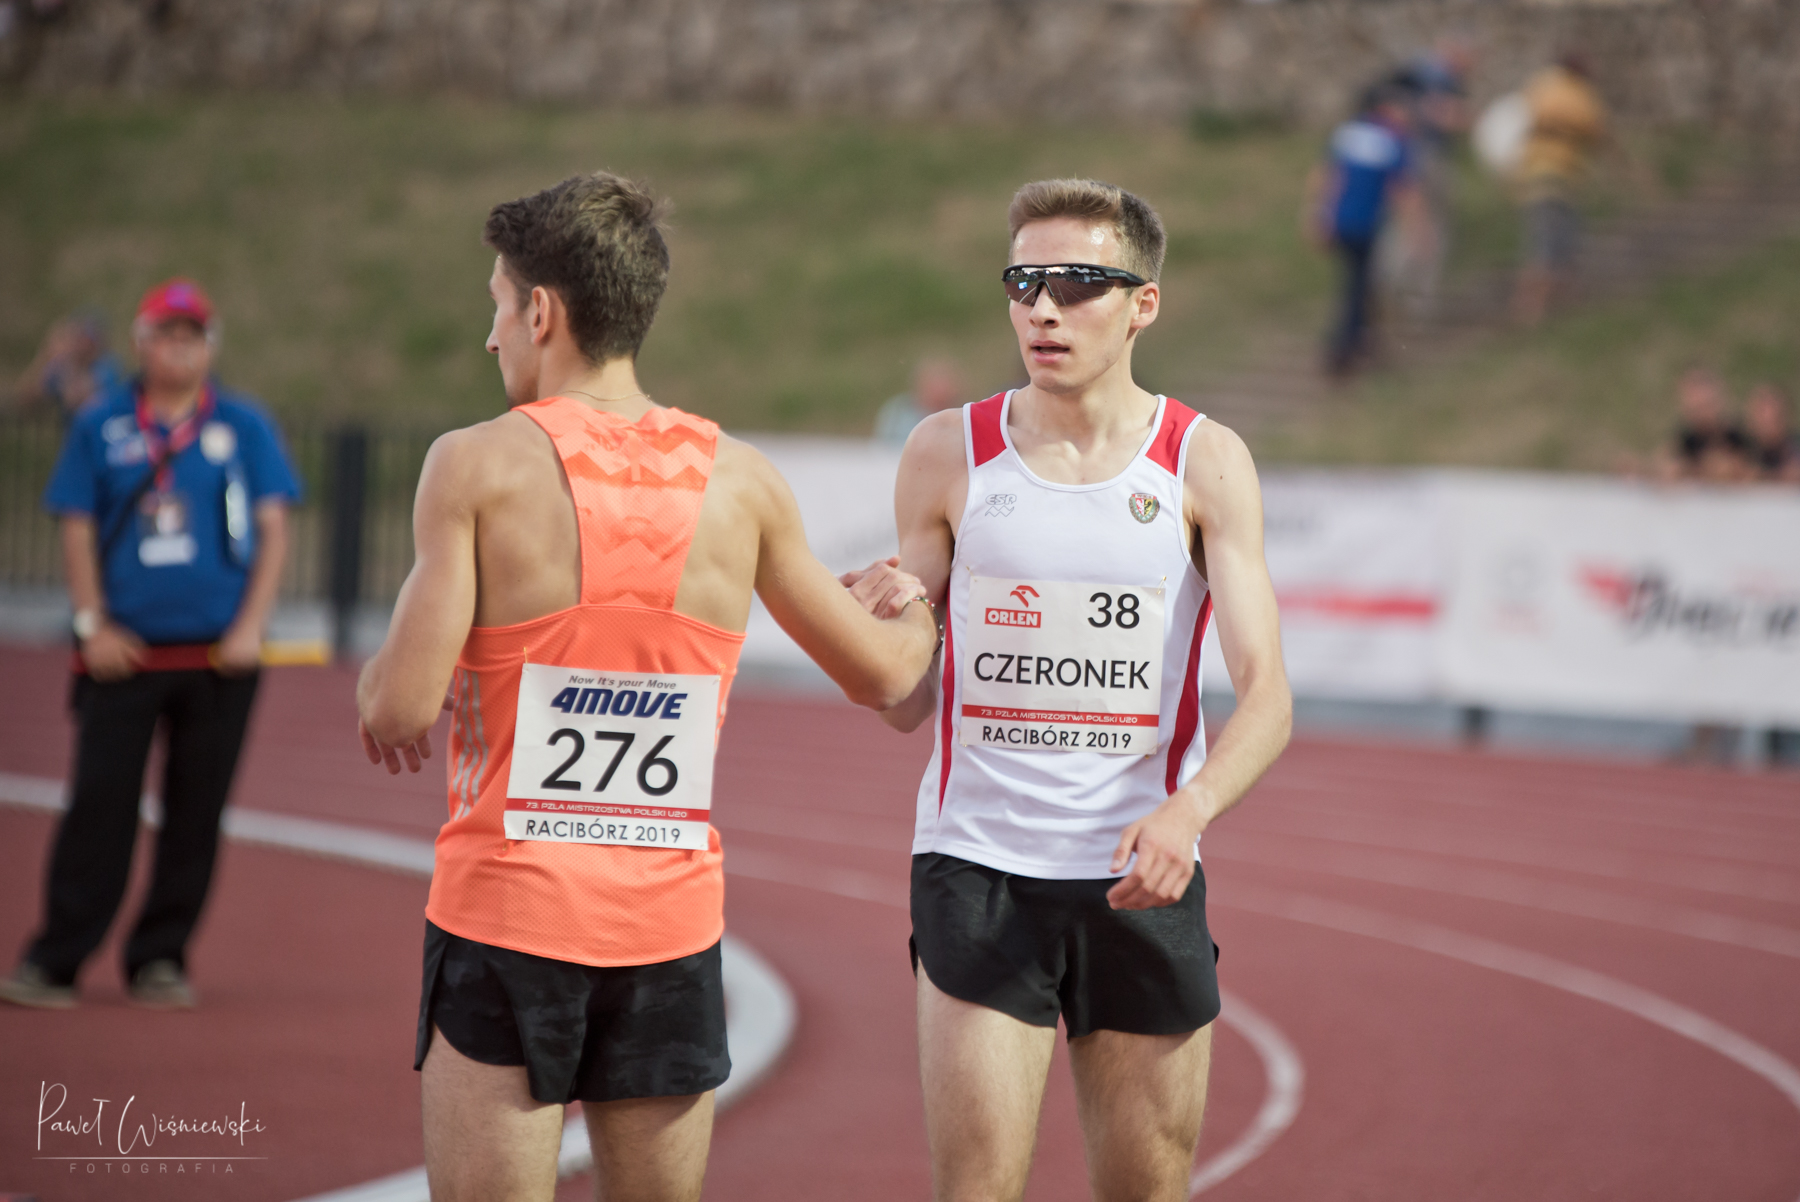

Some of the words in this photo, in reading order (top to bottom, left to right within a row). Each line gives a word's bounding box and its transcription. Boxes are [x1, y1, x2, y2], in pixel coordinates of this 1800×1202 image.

[987, 610, 1039, 626] ORLEN
[1087, 592, 1140, 629] 38
[568, 675, 595, 685] Now
[597, 676, 615, 686] It's
[617, 679, 643, 689] your
[646, 679, 677, 690] Move
[974, 652, 1150, 690] CZERONEK
[549, 687, 688, 720] 4MOVE
[995, 710, 1019, 718] PZLA
[1020, 712, 1084, 722] MISTRZOSTWA
[1086, 715, 1117, 723] POLSKI
[1119, 716, 1138, 724] U20
[982, 725, 1080, 747] RACIBÓRZ
[1086, 732, 1132, 749] 2019
[540, 727, 679, 796] 276
[525, 801, 539, 809] 73.
[541, 802, 565, 811] PZLA
[566, 804, 632, 815] MISTRZOSTWA
[633, 808, 666, 818] POLSKI
[668, 810, 687, 818] U20
[525, 818, 628, 840] RACIBÓRZ
[634, 825, 681, 844] 2019
